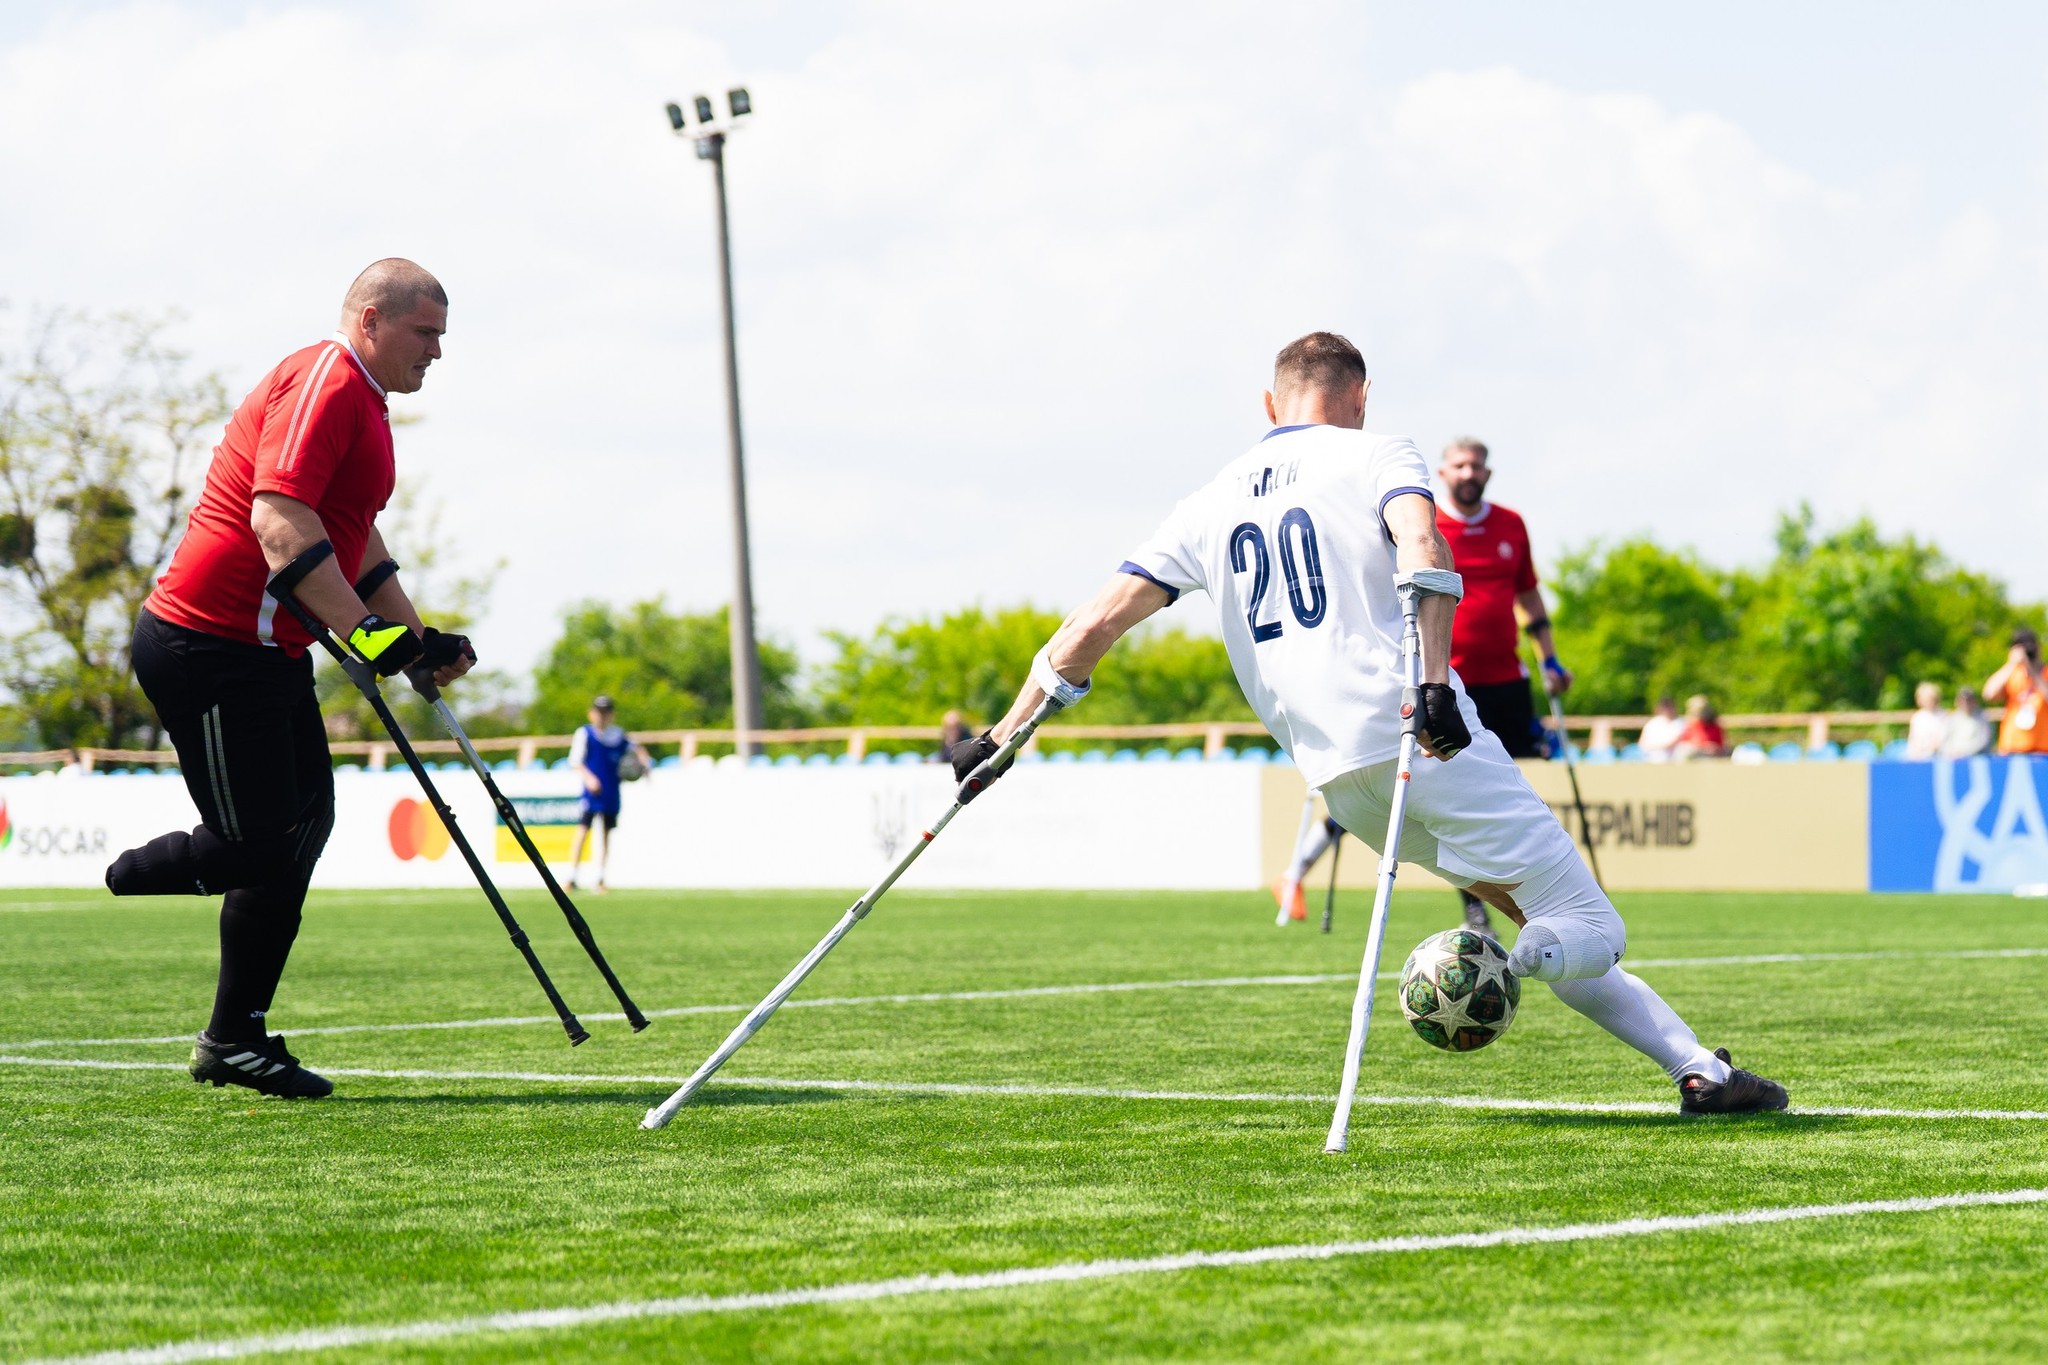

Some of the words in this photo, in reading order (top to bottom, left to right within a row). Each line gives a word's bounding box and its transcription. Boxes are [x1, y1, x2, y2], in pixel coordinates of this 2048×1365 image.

[1229, 506, 1327, 644] 20
[19, 827, 107, 855] SOCAR
[1545, 802, 1696, 847] ТЕРАНІВ
